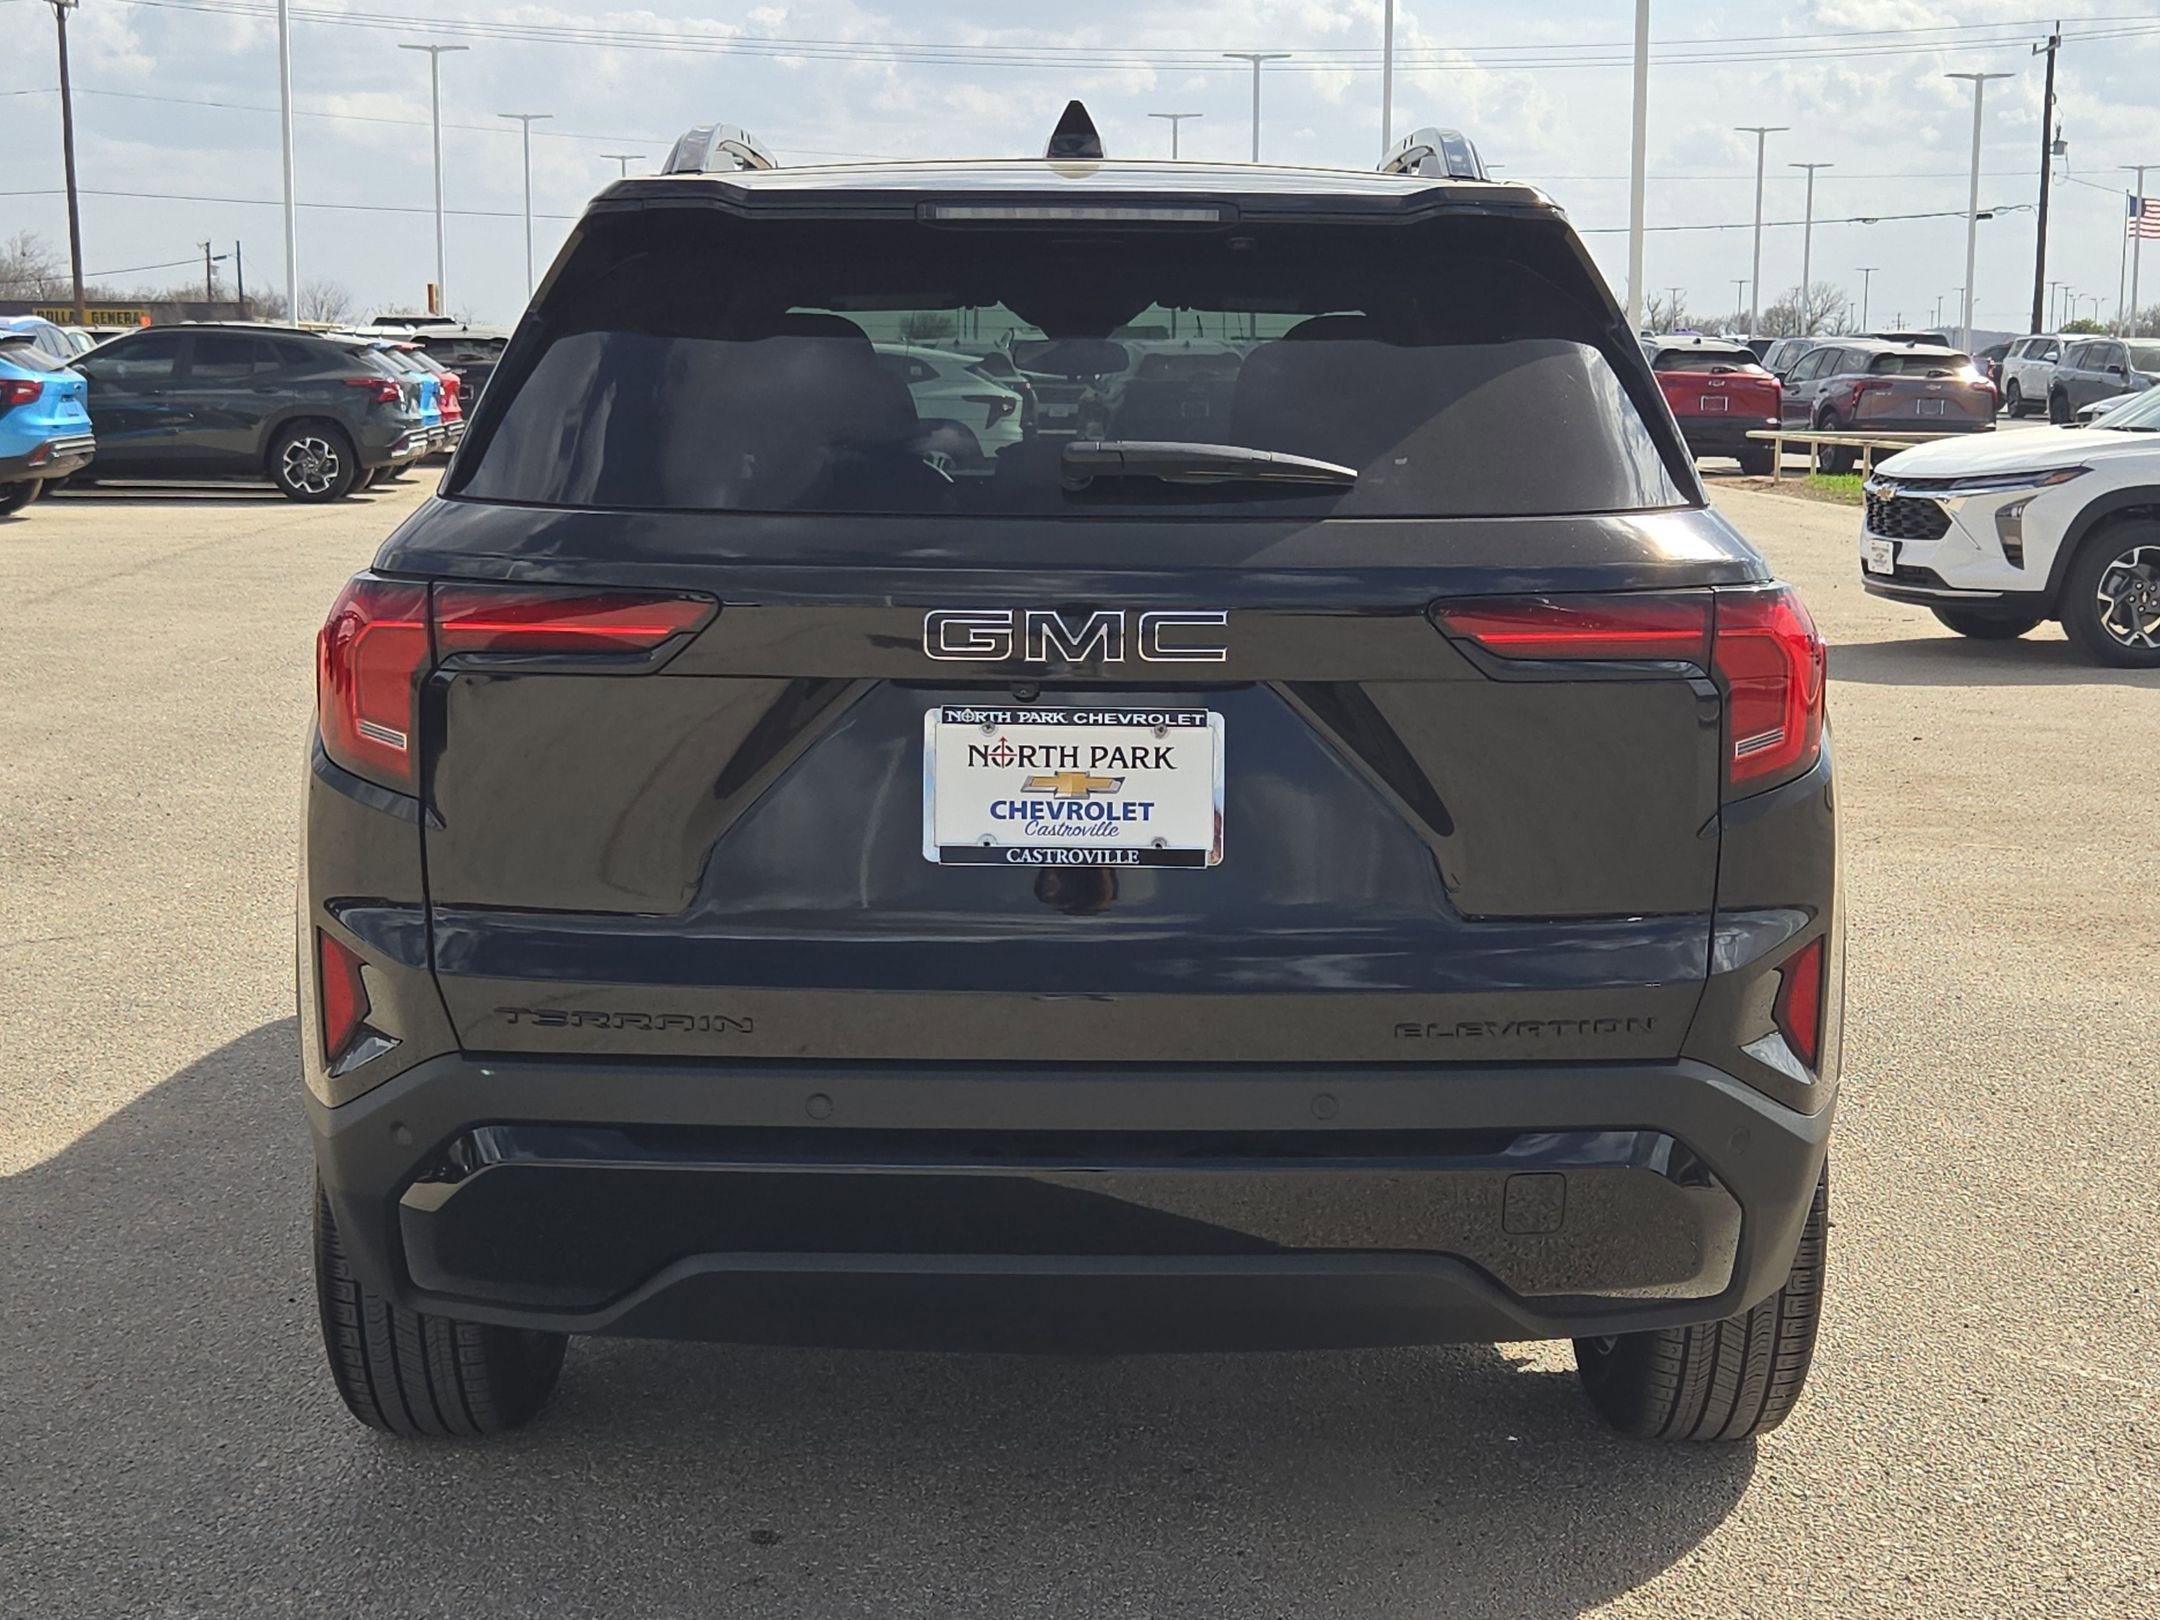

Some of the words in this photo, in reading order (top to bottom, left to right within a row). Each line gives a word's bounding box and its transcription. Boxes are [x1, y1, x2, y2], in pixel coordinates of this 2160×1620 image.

[924, 609, 1228, 662] GMC
[946, 709, 1011, 723] NORTH
[1018, 711, 1067, 724] PARK
[1073, 712, 1204, 726] CHEVROLET
[968, 736, 1078, 769] NORTH
[1091, 745, 1177, 769] PARK
[990, 801, 1154, 821] CHEVROLET
[1024, 820, 1119, 837] Castroville
[1006, 848, 1140, 864] CASTROVILLE
[494, 1007, 753, 1033] TERRAIN
[1395, 1017, 1657, 1038] ELEVATION
